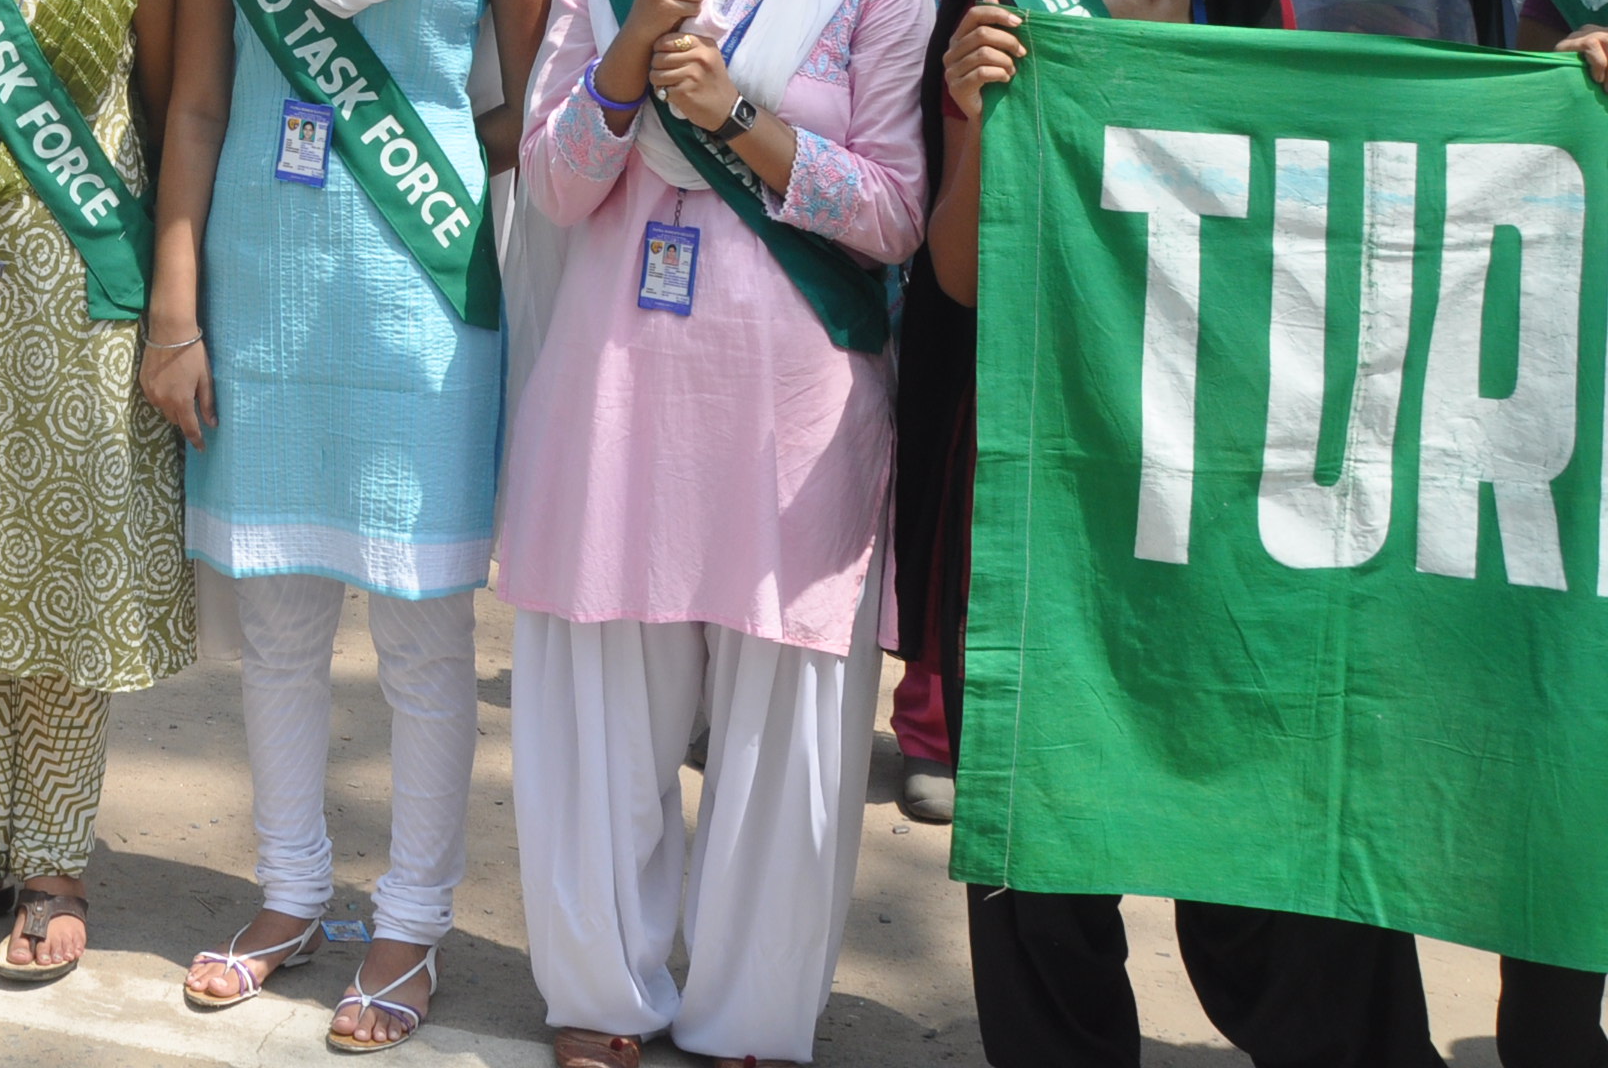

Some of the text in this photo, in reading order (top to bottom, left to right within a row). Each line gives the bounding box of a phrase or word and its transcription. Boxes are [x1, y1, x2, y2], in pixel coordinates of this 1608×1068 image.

[16, 101, 120, 227] FORCE
[284, 8, 379, 121] TASK
[360, 114, 471, 249] FORCE
[1100, 125, 1608, 597] TUR
